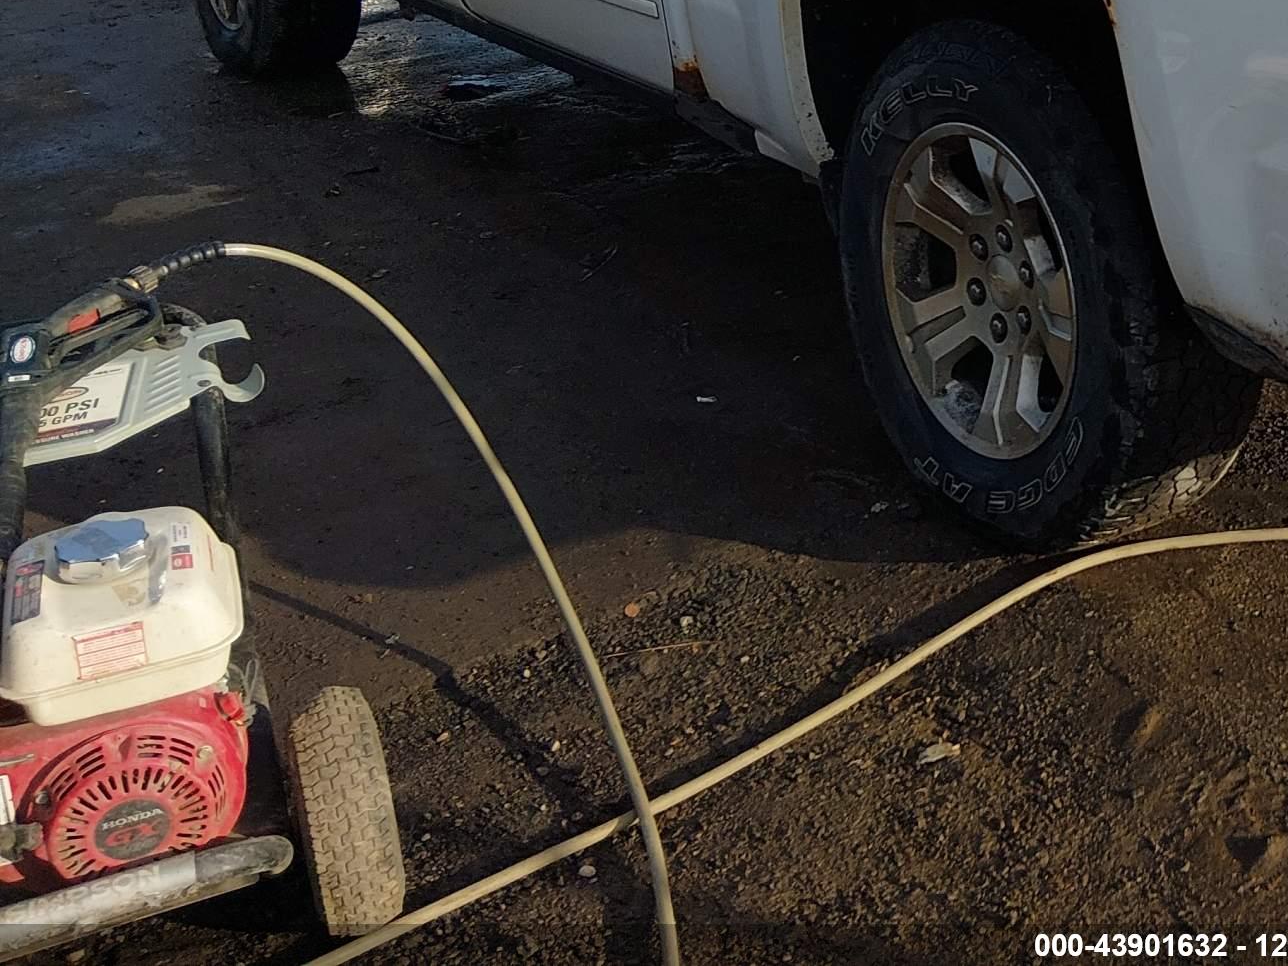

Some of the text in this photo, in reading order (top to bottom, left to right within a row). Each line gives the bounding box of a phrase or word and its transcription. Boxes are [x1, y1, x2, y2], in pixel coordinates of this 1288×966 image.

[860, 75, 979, 157] KELLY
[51, 411, 88, 425] GPM
[65, 397, 100, 414] PSI
[913, 416, 1084, 514] EDGE AT
[102, 807, 165, 831] HONDA
[104, 818, 161, 847] GX
